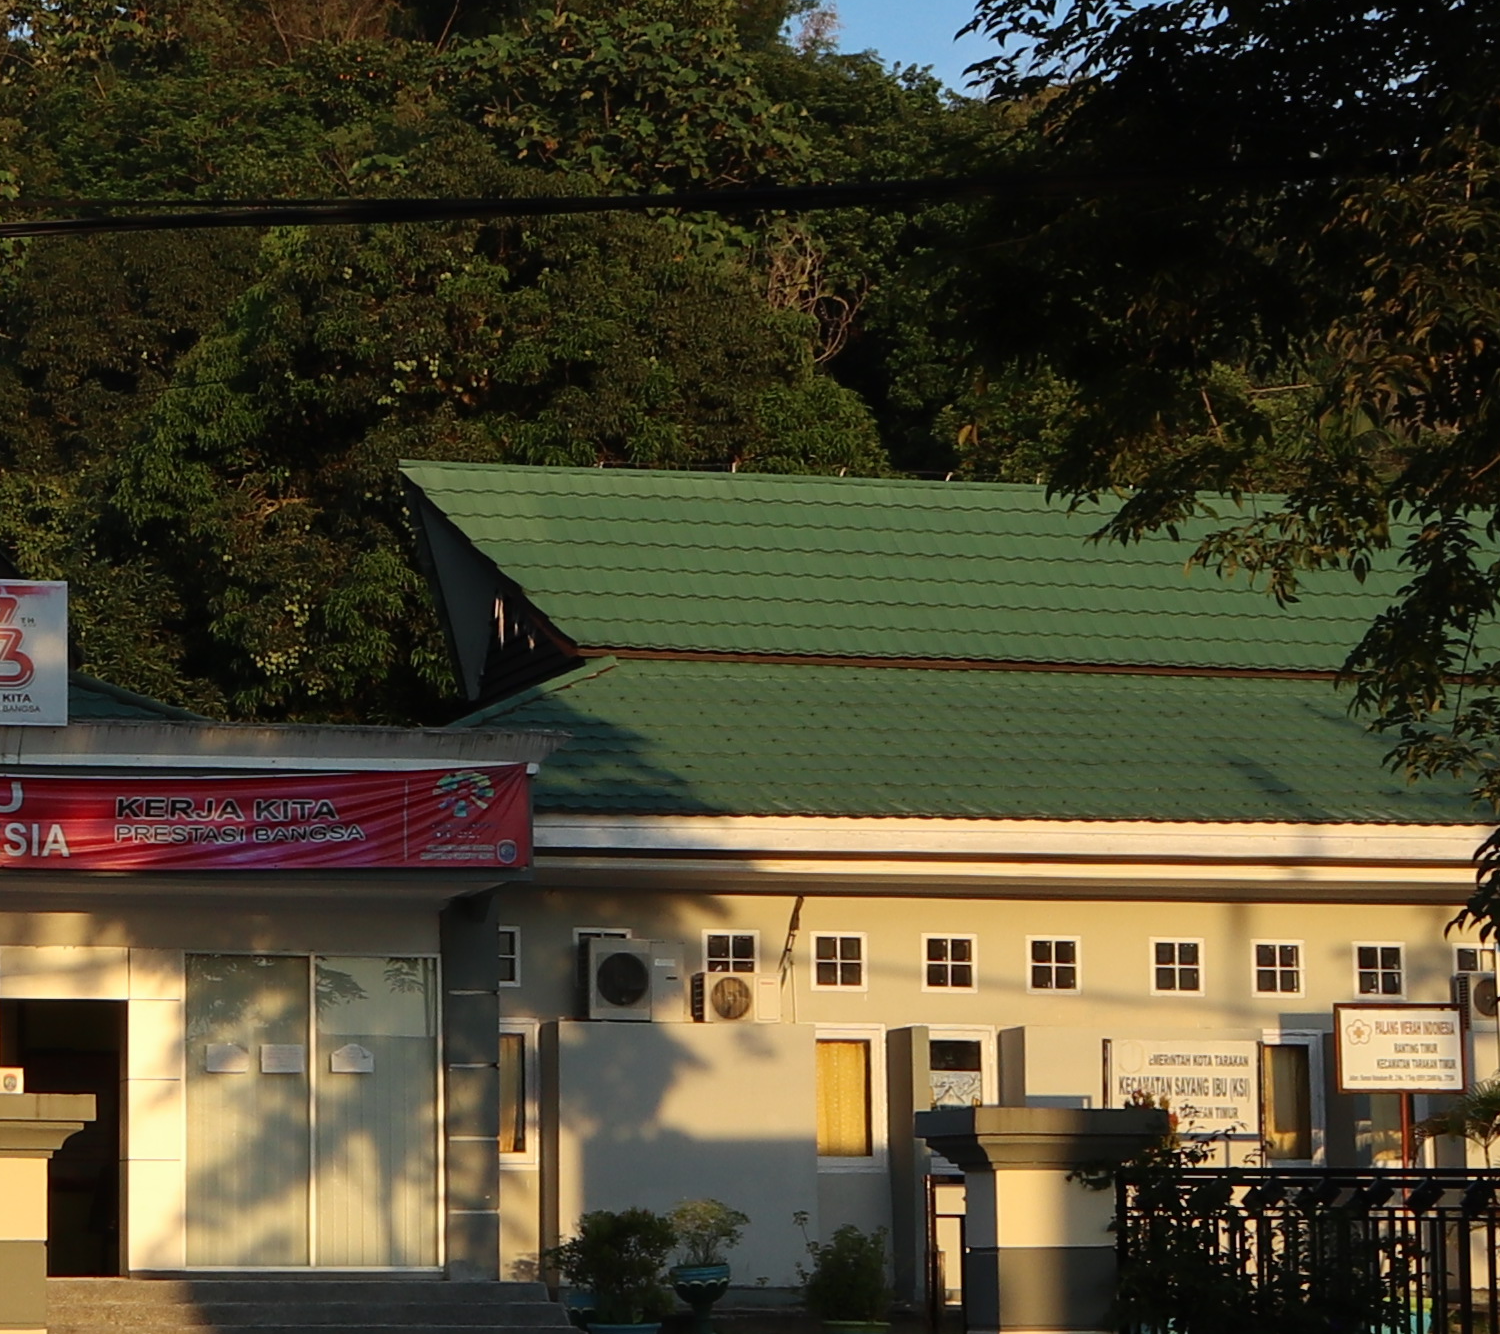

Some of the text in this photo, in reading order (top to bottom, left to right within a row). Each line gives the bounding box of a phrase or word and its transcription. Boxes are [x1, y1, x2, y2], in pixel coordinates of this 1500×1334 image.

[2, 693, 31, 703] KITA
[2, 704, 41, 713] BANGSA
[115, 797, 340, 821] KERJA KITA
[114, 823, 366, 844] PRESTASI BANGSA
[1214, 1055, 1248, 1067] TARAKAN
[1119, 1076, 1172, 1095] KECAMATAN
[1175, 1077, 1209, 1097] SAYANG
[1213, 1078, 1227, 1097] IBU
